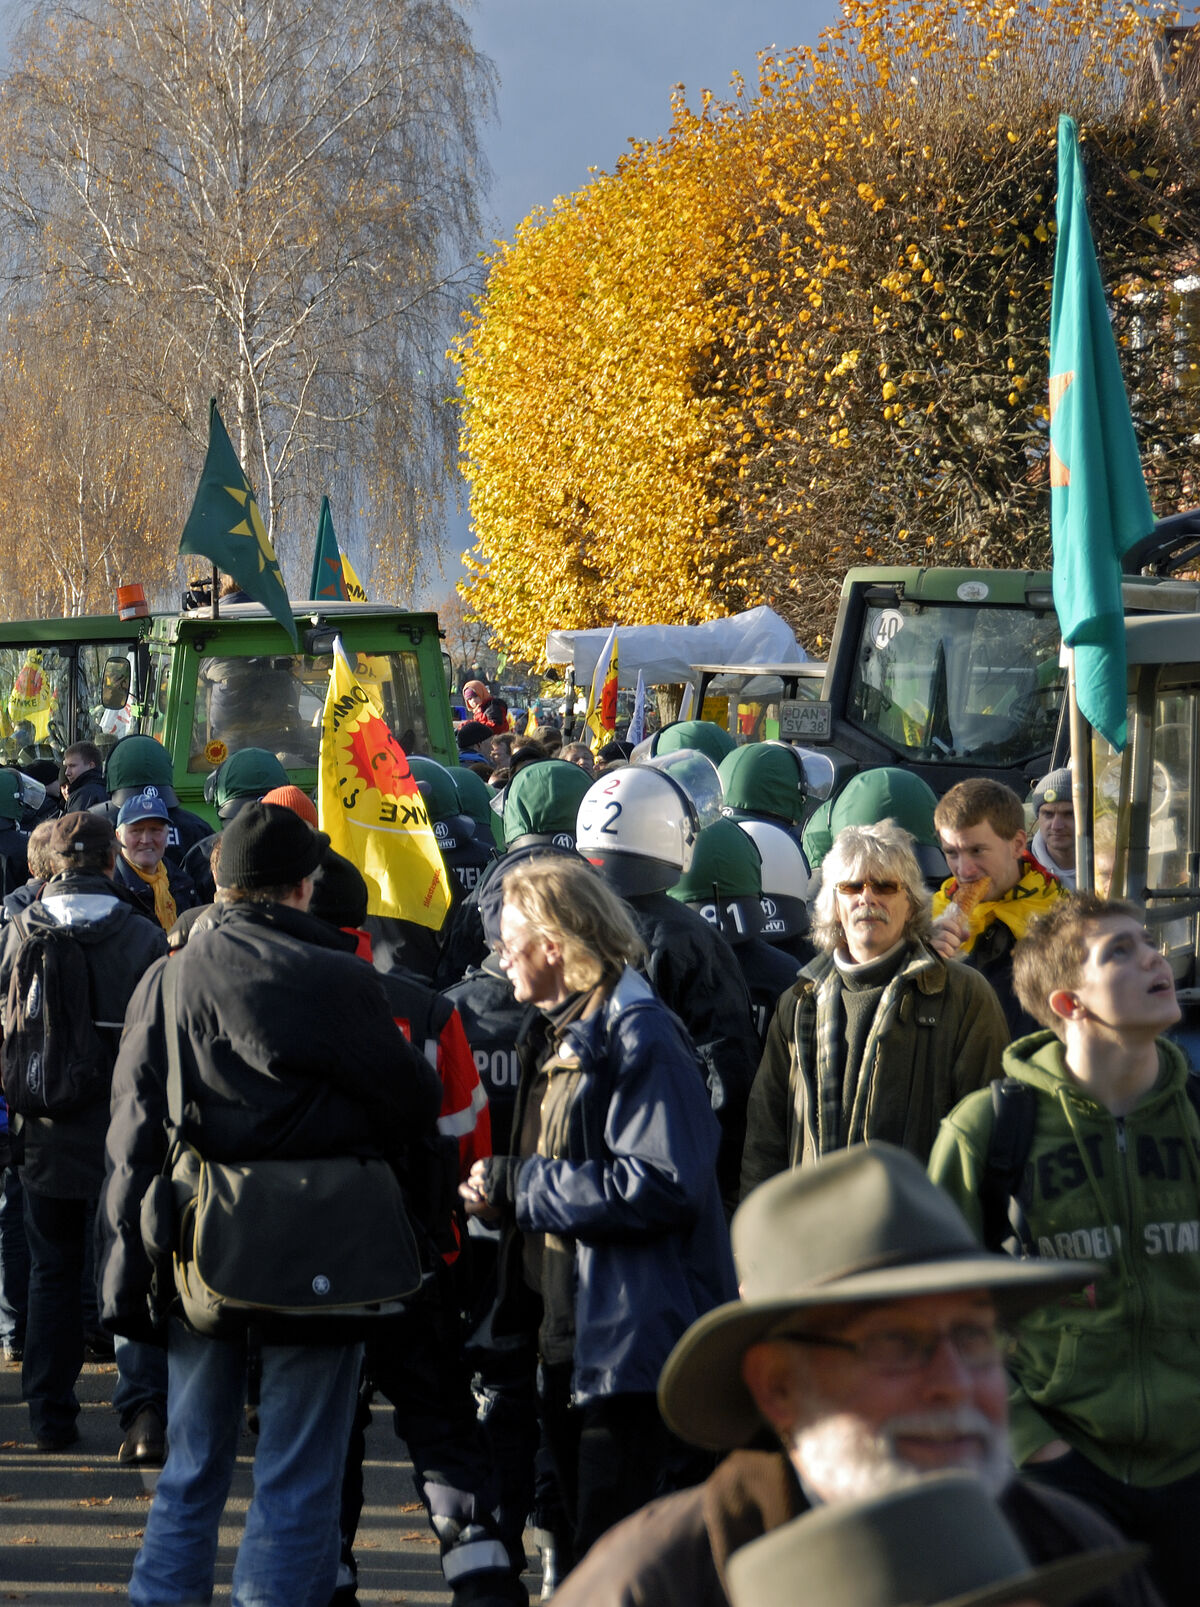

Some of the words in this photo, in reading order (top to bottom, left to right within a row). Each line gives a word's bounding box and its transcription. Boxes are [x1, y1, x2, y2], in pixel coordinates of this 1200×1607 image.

[878, 617, 899, 641] 40
[792, 707, 819, 720] DAN
[810, 720, 825, 733] 38
[603, 779, 621, 796] 2
